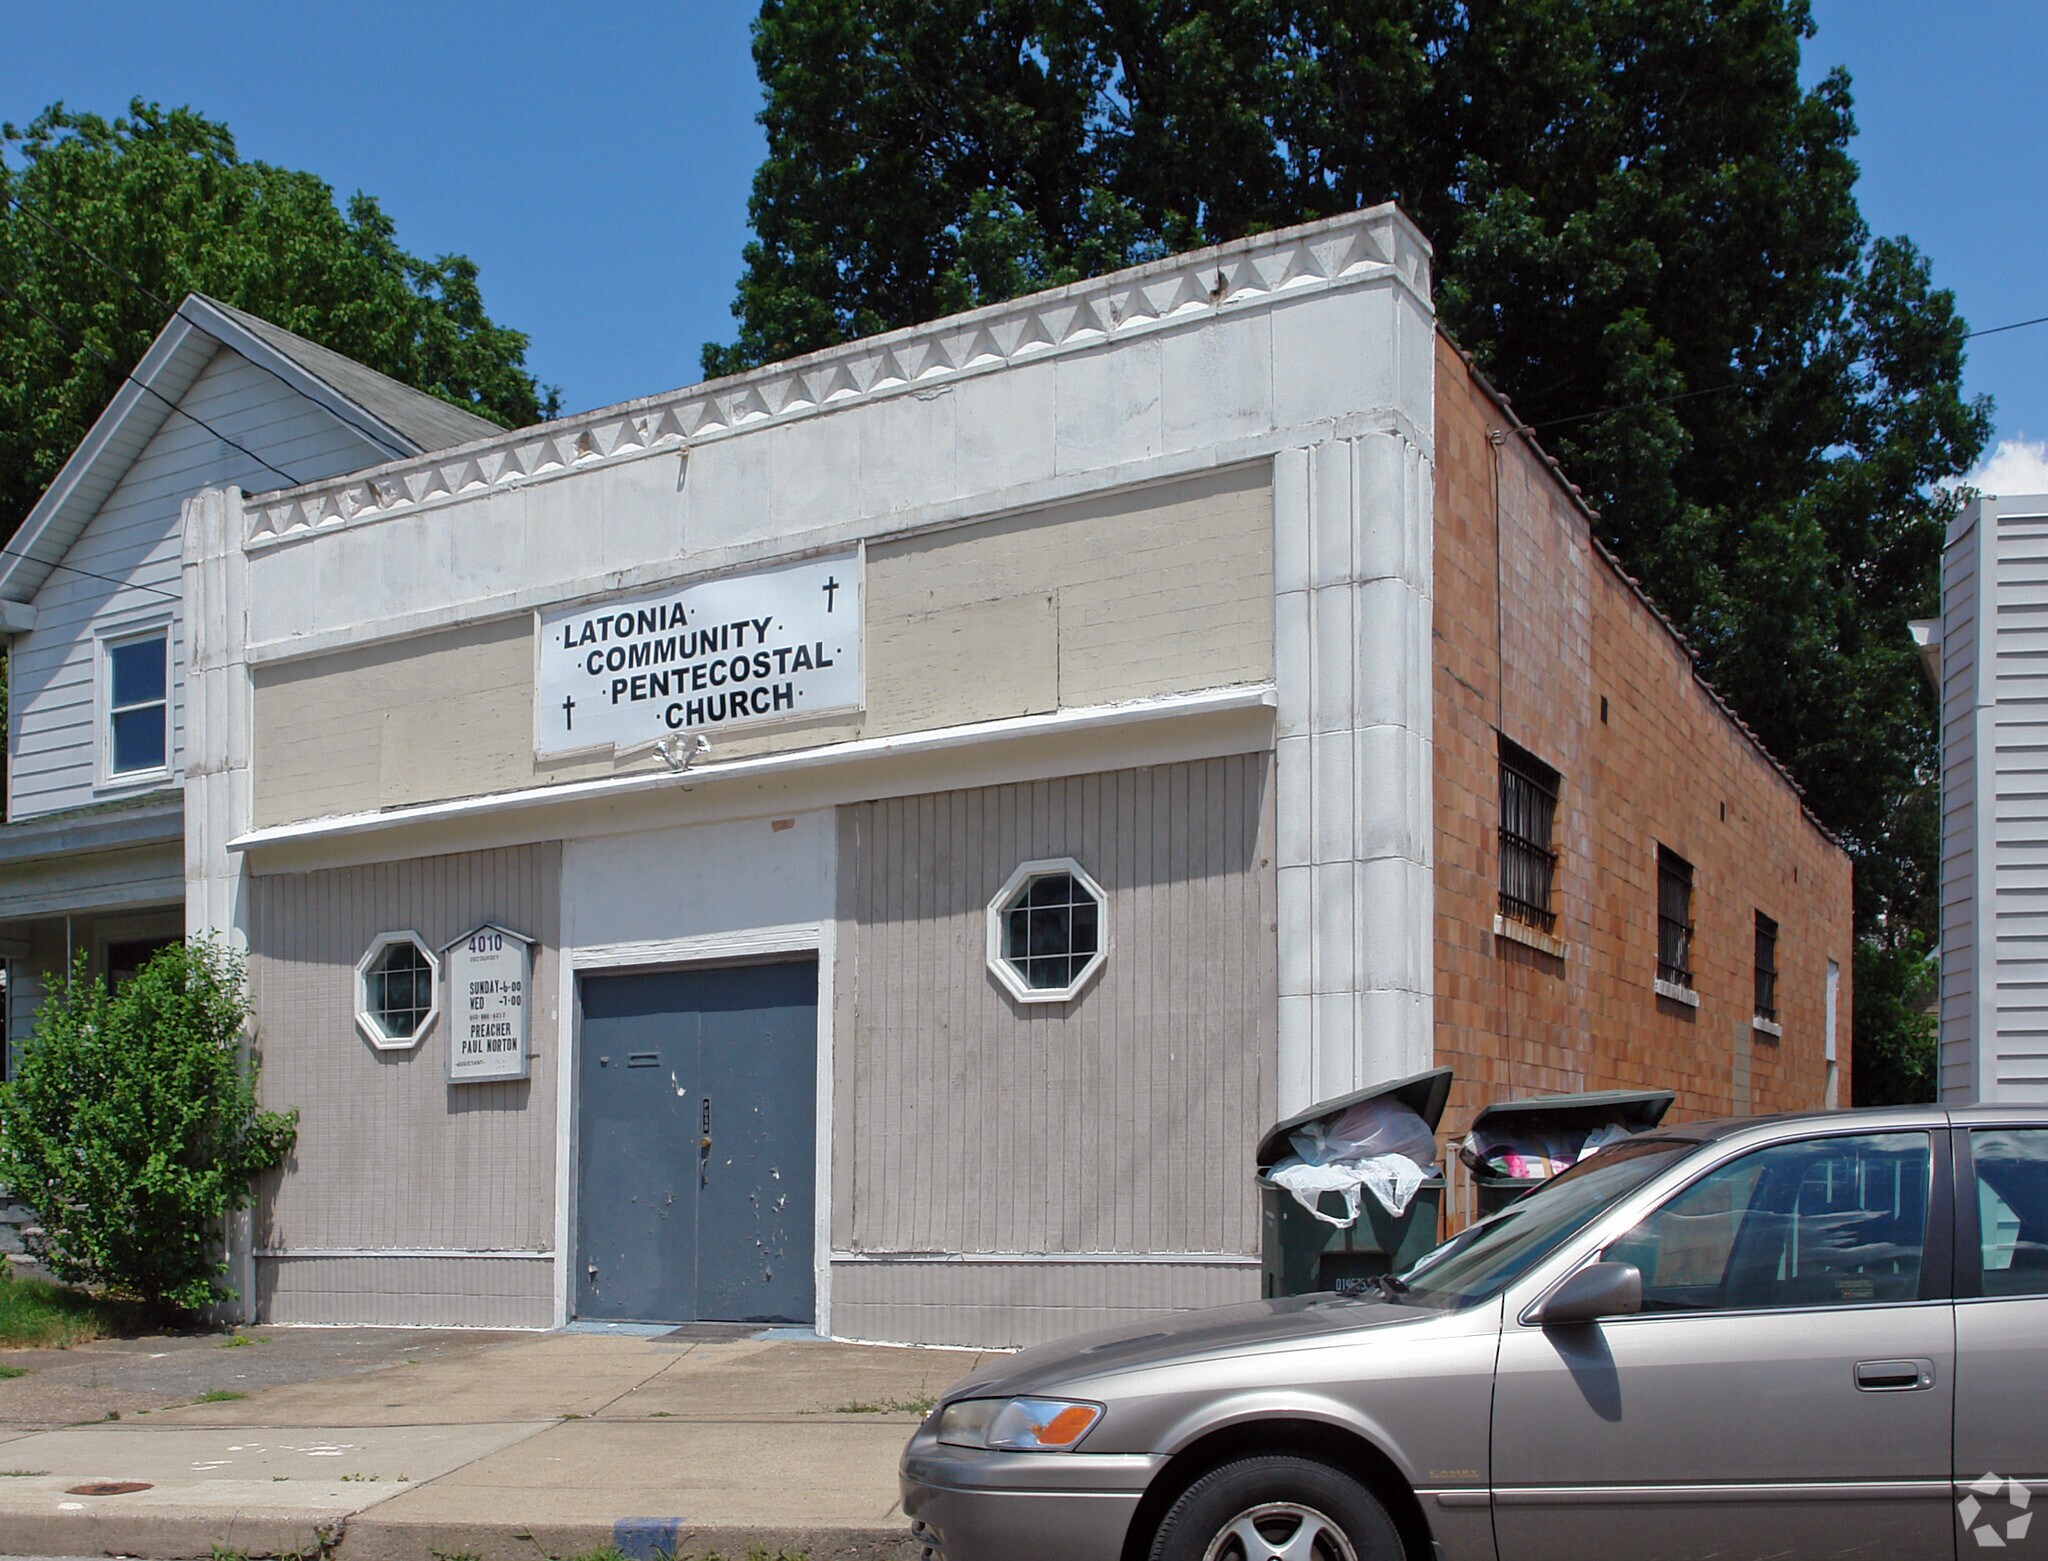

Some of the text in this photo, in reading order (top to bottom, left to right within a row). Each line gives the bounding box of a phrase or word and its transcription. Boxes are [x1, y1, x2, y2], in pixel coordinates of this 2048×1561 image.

[564, 602, 688, 649] LATONIA
[586, 616, 773, 675] COMMUNITY
[612, 642, 833, 705] PENTECOSTAL
[665, 682, 793, 729] CHURCH
[469, 934, 502, 953] 4010
[470, 997, 484, 1010] WED
[462, 1038, 517, 1054] PAUL NORTON
[471, 1023, 511, 1038] PREACHER
